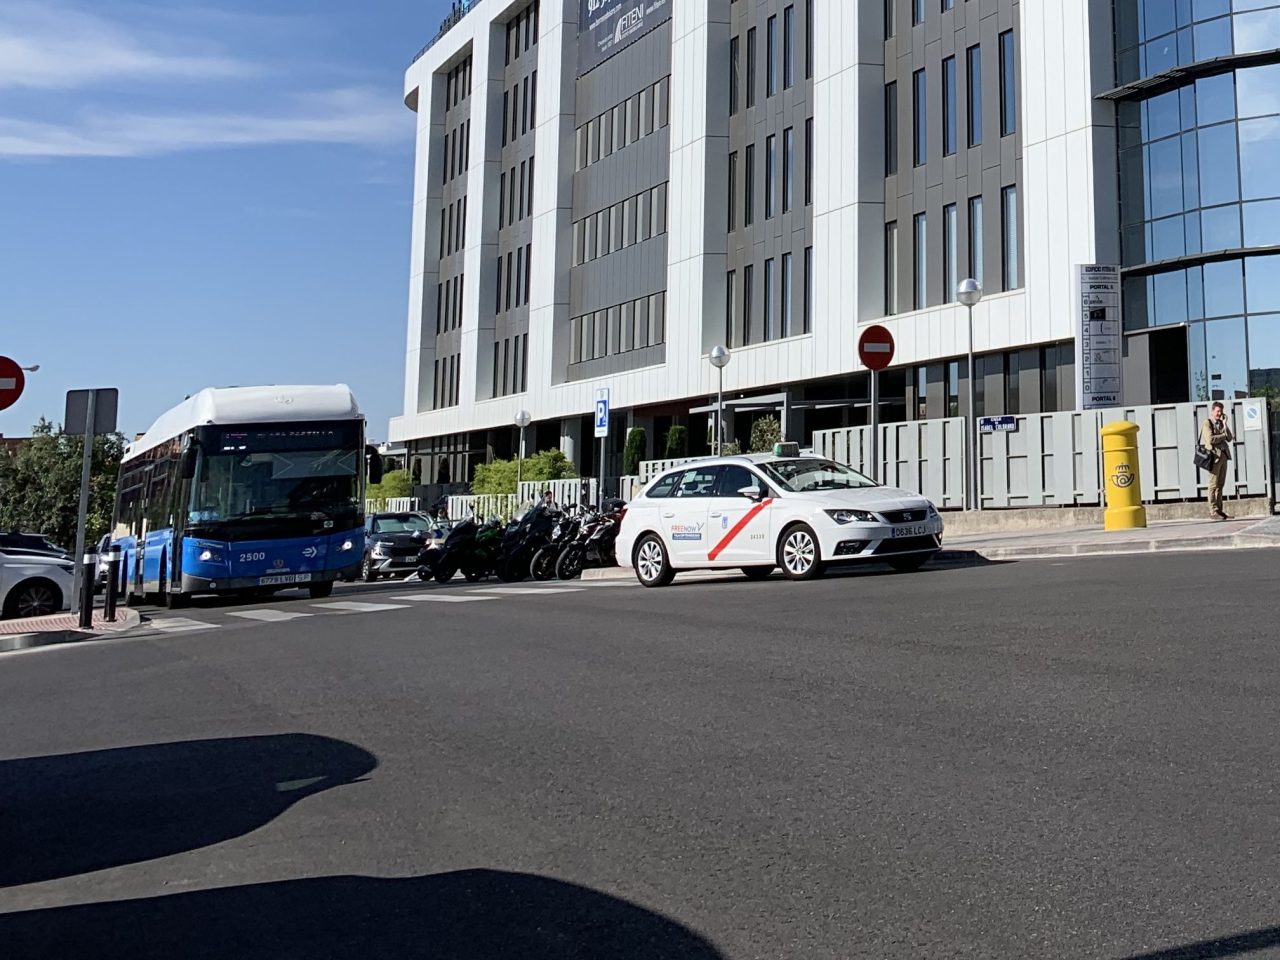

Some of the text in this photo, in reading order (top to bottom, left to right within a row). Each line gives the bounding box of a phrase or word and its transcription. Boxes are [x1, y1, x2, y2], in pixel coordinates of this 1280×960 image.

[621, 3, 643, 32] FITENI
[895, 526, 926, 536] 0636 LCJ
[239, 552, 266, 562] 2500
